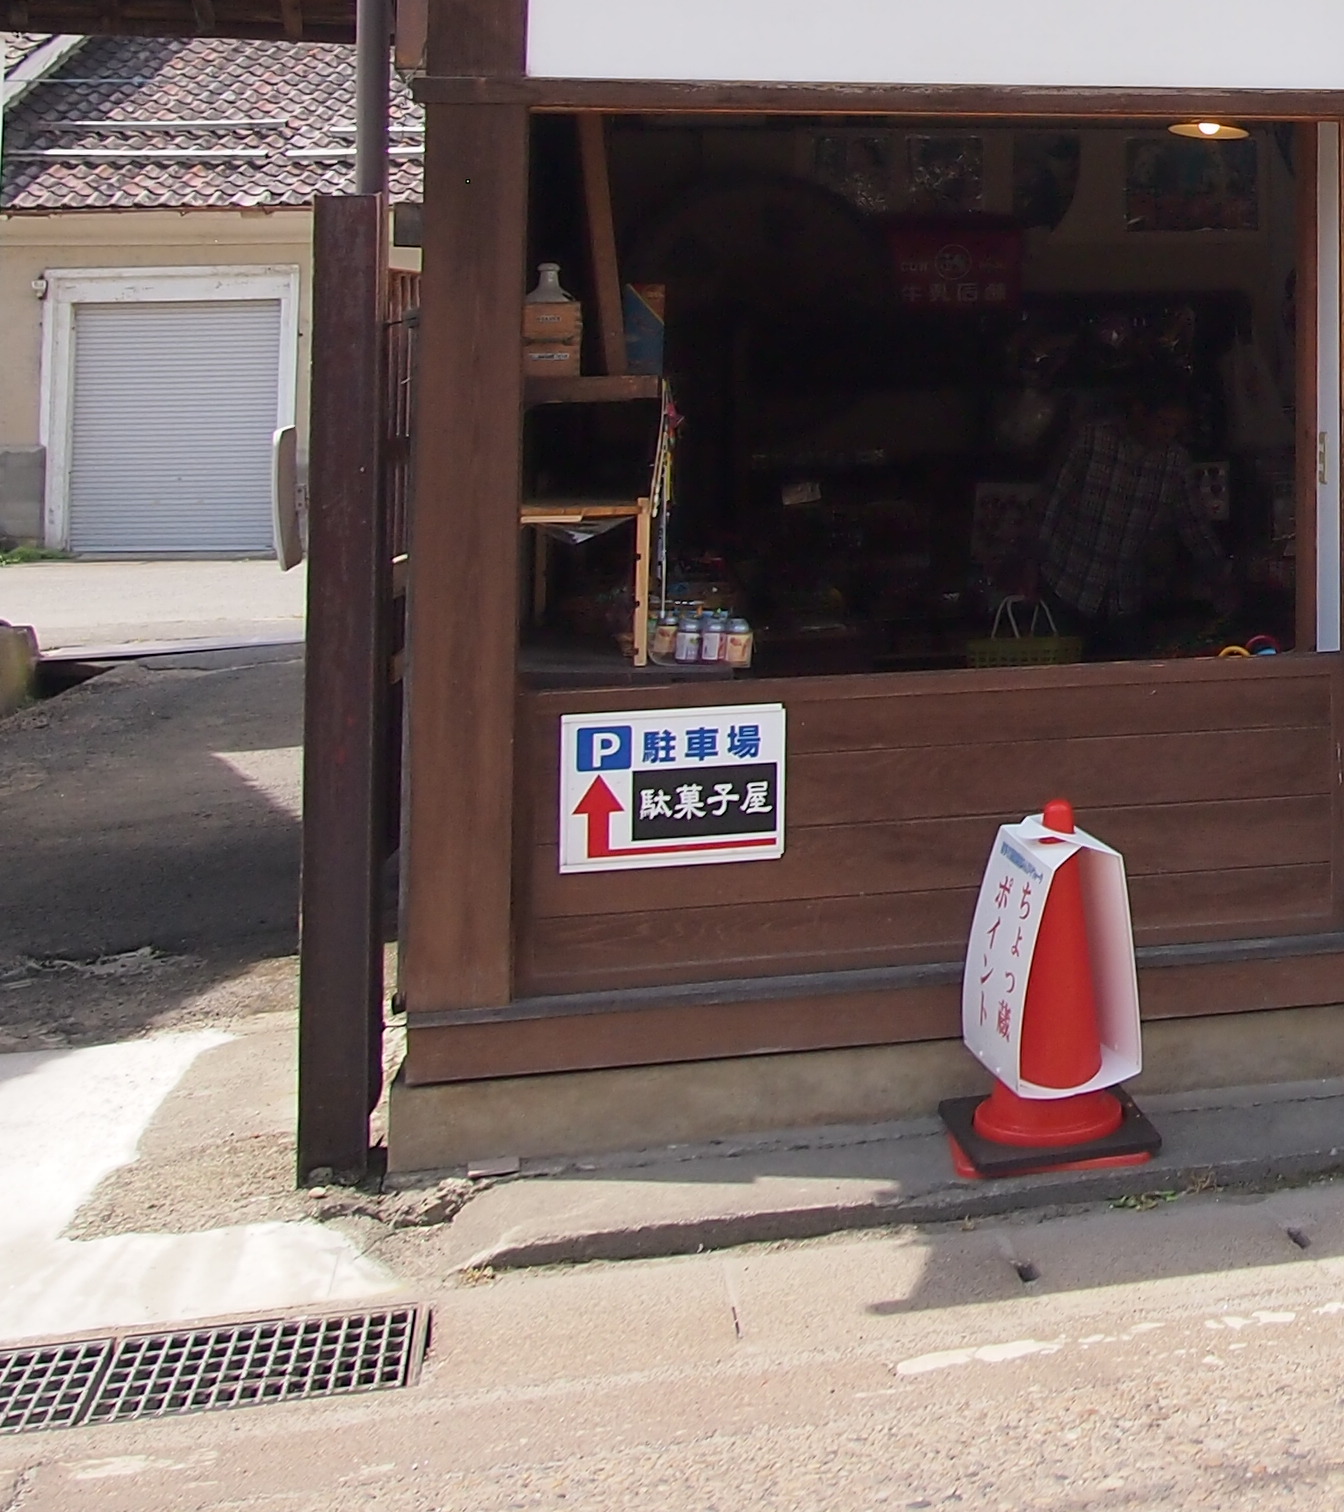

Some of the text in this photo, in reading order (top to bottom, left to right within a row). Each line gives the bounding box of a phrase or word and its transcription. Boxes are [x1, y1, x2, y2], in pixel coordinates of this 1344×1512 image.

[642, 724, 761, 763] 駐車場
[639, 780, 773, 821] 駄菓子屋
[977, 876, 1014, 1027] ポイント
[996, 881, 1032, 1043] ちょっ蔵
